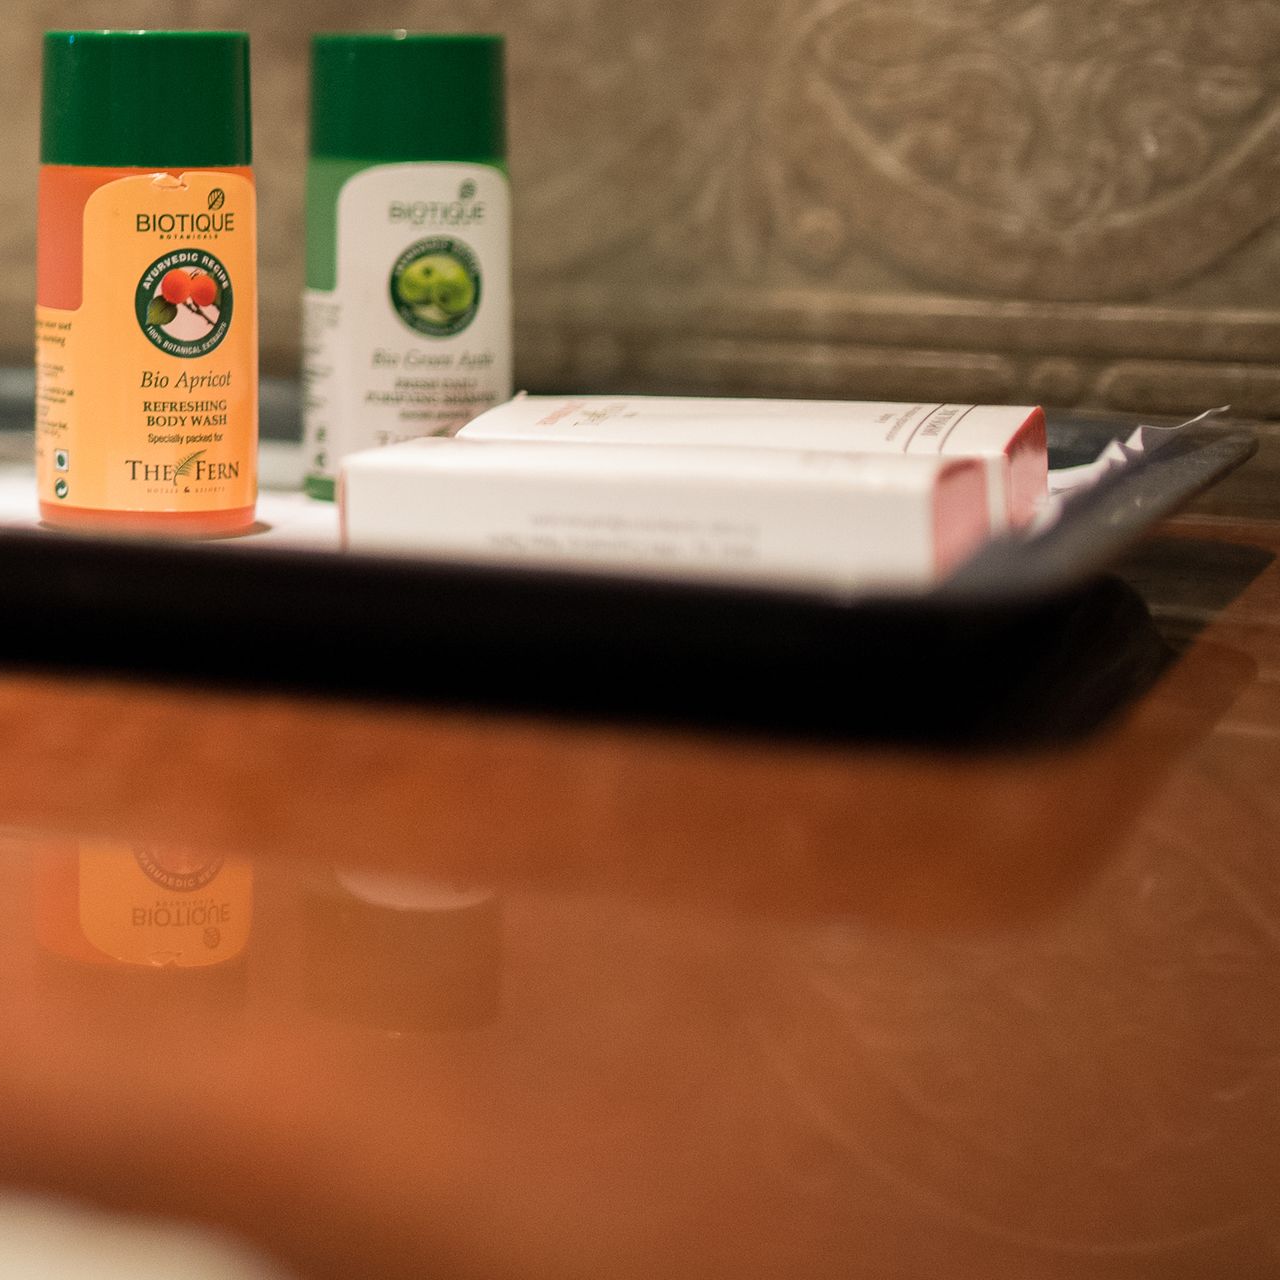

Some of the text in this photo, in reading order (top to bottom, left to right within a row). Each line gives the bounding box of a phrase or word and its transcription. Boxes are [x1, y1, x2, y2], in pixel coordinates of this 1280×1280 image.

[135, 212, 235, 233] BIOTIQUE
[388, 201, 485, 224] BIOTIQUE
[142, 252, 229, 291] AYURVEDIC RECIPE
[146, 321, 228, 355] 100% BOTANICAL EXTRACTS
[140, 370, 232, 394] Bio Apricot
[143, 399, 228, 413] REFRESHING
[146, 414, 228, 427] BODY WASH
[147, 433, 224, 445] Specially packed for
[124, 460, 240, 481] THE FERN
